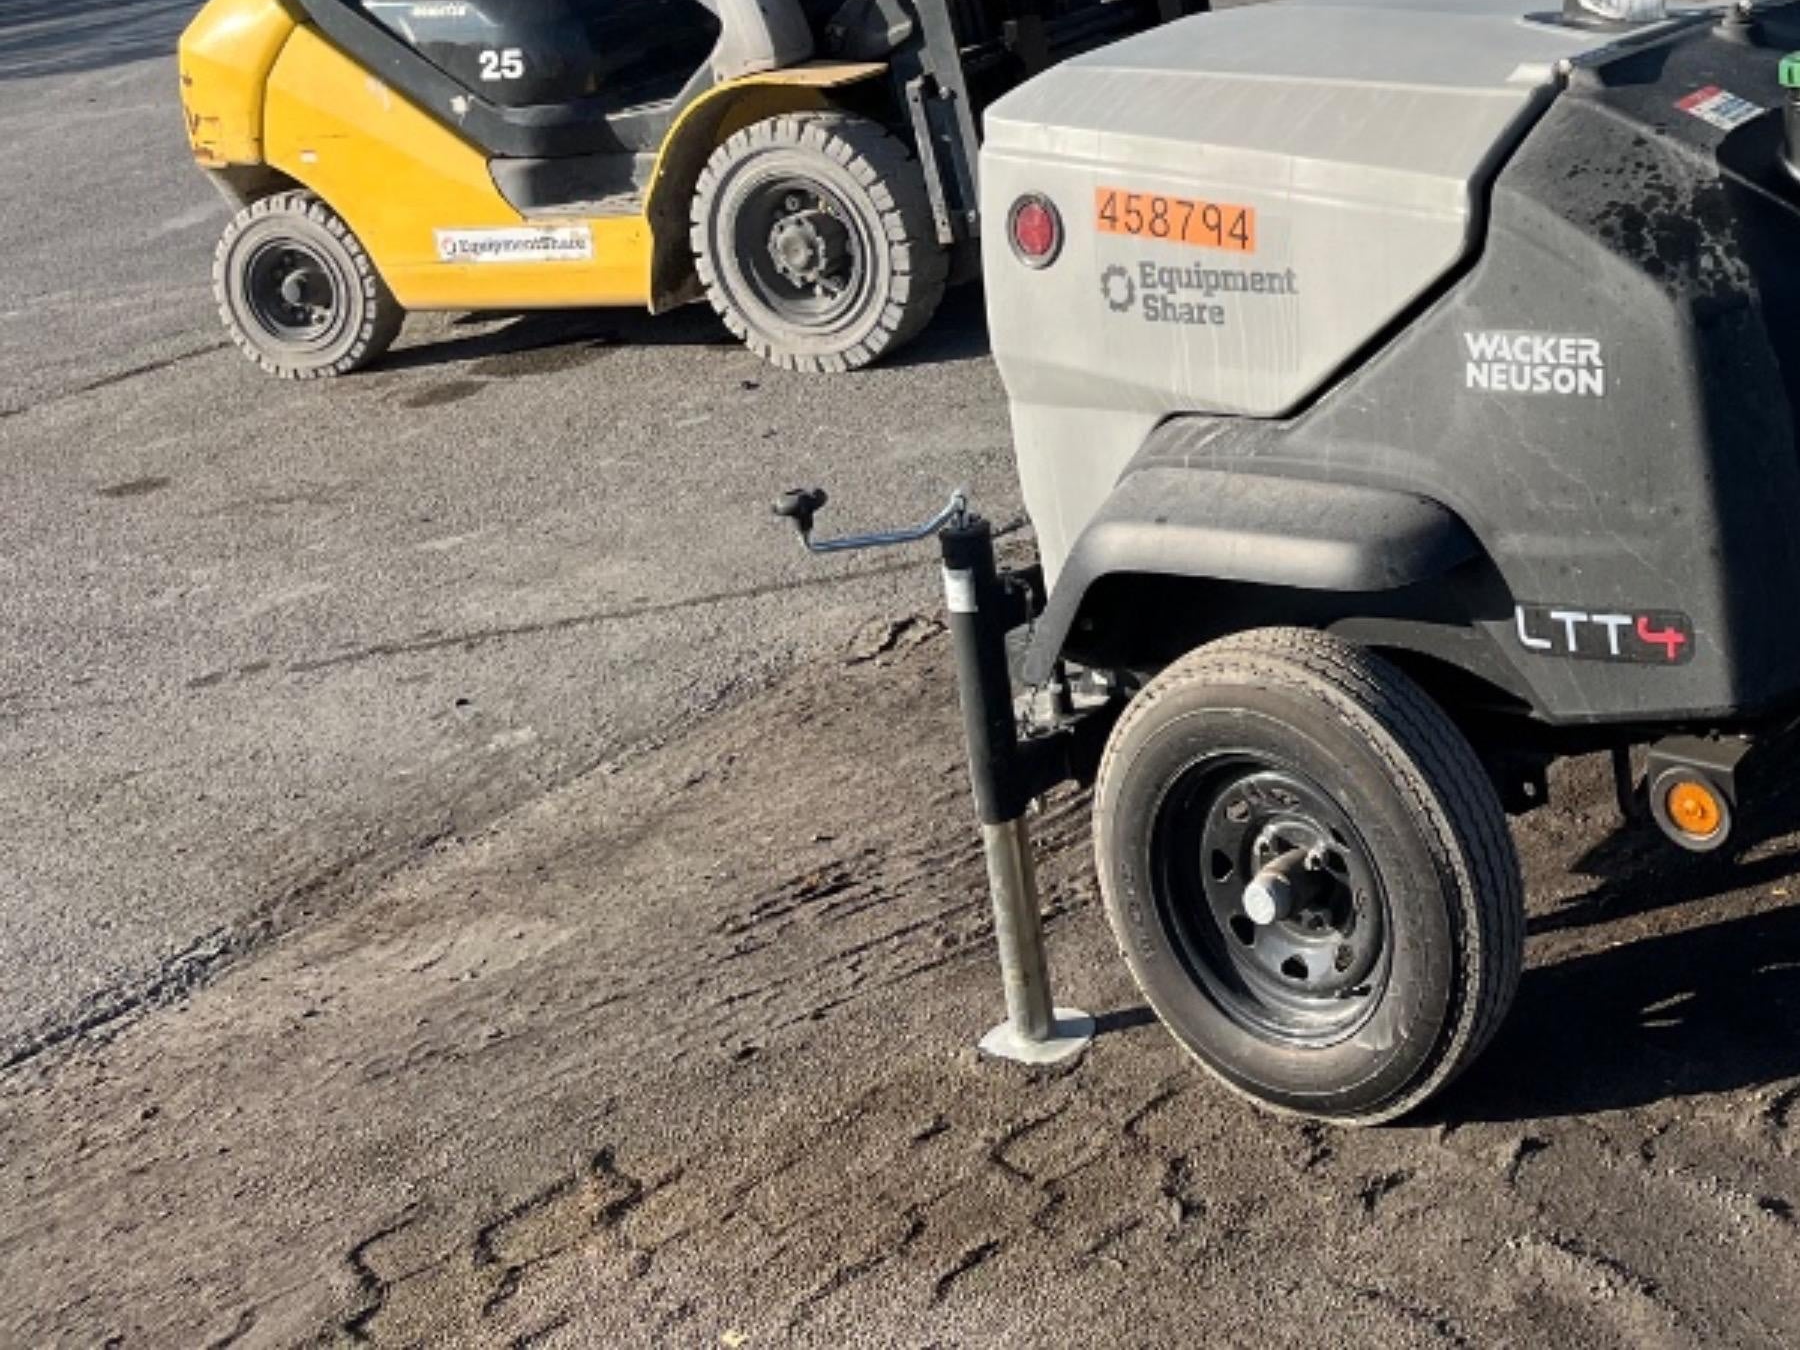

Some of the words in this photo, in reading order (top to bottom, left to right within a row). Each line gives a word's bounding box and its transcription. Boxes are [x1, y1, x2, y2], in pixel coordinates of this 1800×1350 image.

[479, 47, 524, 81] 25
[1098, 191, 1249, 250] 458794
[1138, 260, 1300, 298] Equipment
[1141, 292, 1226, 326] Share
[1463, 331, 1605, 368] WACKER
[1465, 361, 1605, 398] NEUSON
[1515, 604, 1688, 662] LTT4
